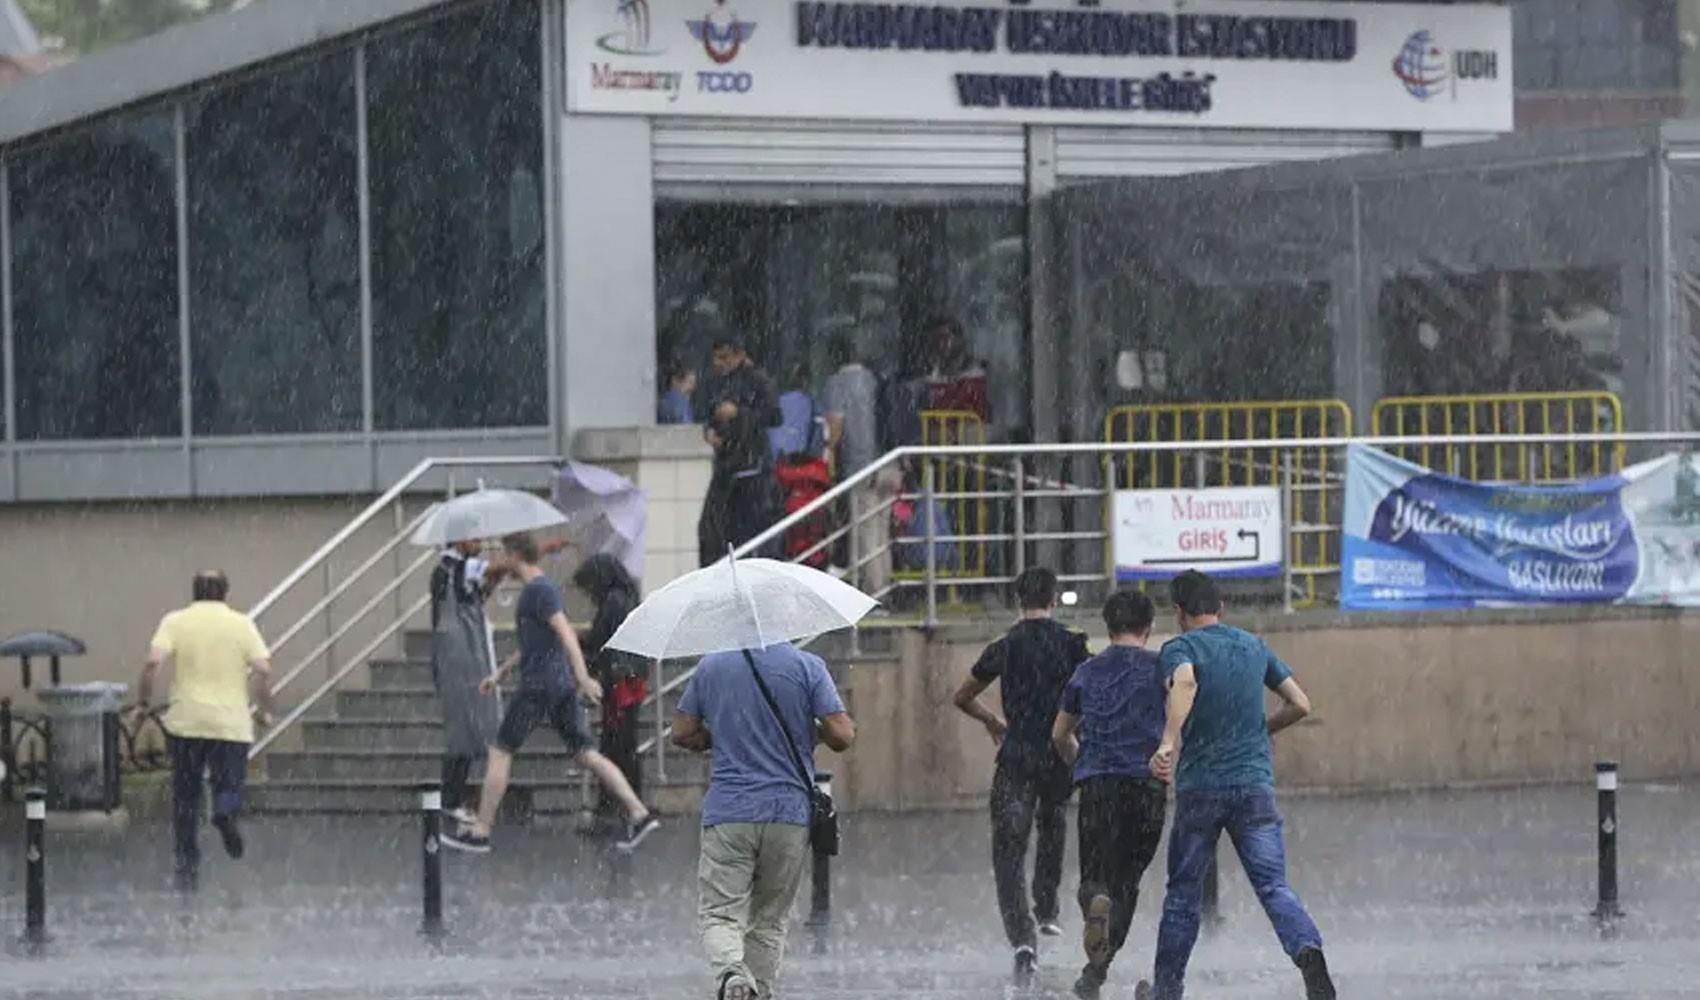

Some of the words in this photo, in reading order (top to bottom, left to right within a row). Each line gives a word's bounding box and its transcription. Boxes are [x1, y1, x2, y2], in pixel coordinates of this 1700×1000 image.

[795, 1, 1001, 52] MARMARAY
[1455, 49, 1498, 80] UDH
[591, 62, 682, 101] Marmaray
[696, 71, 753, 93] TCDD
[1171, 494, 1273, 525] Marmaray
[1178, 528, 1229, 555] GİRİŞ
